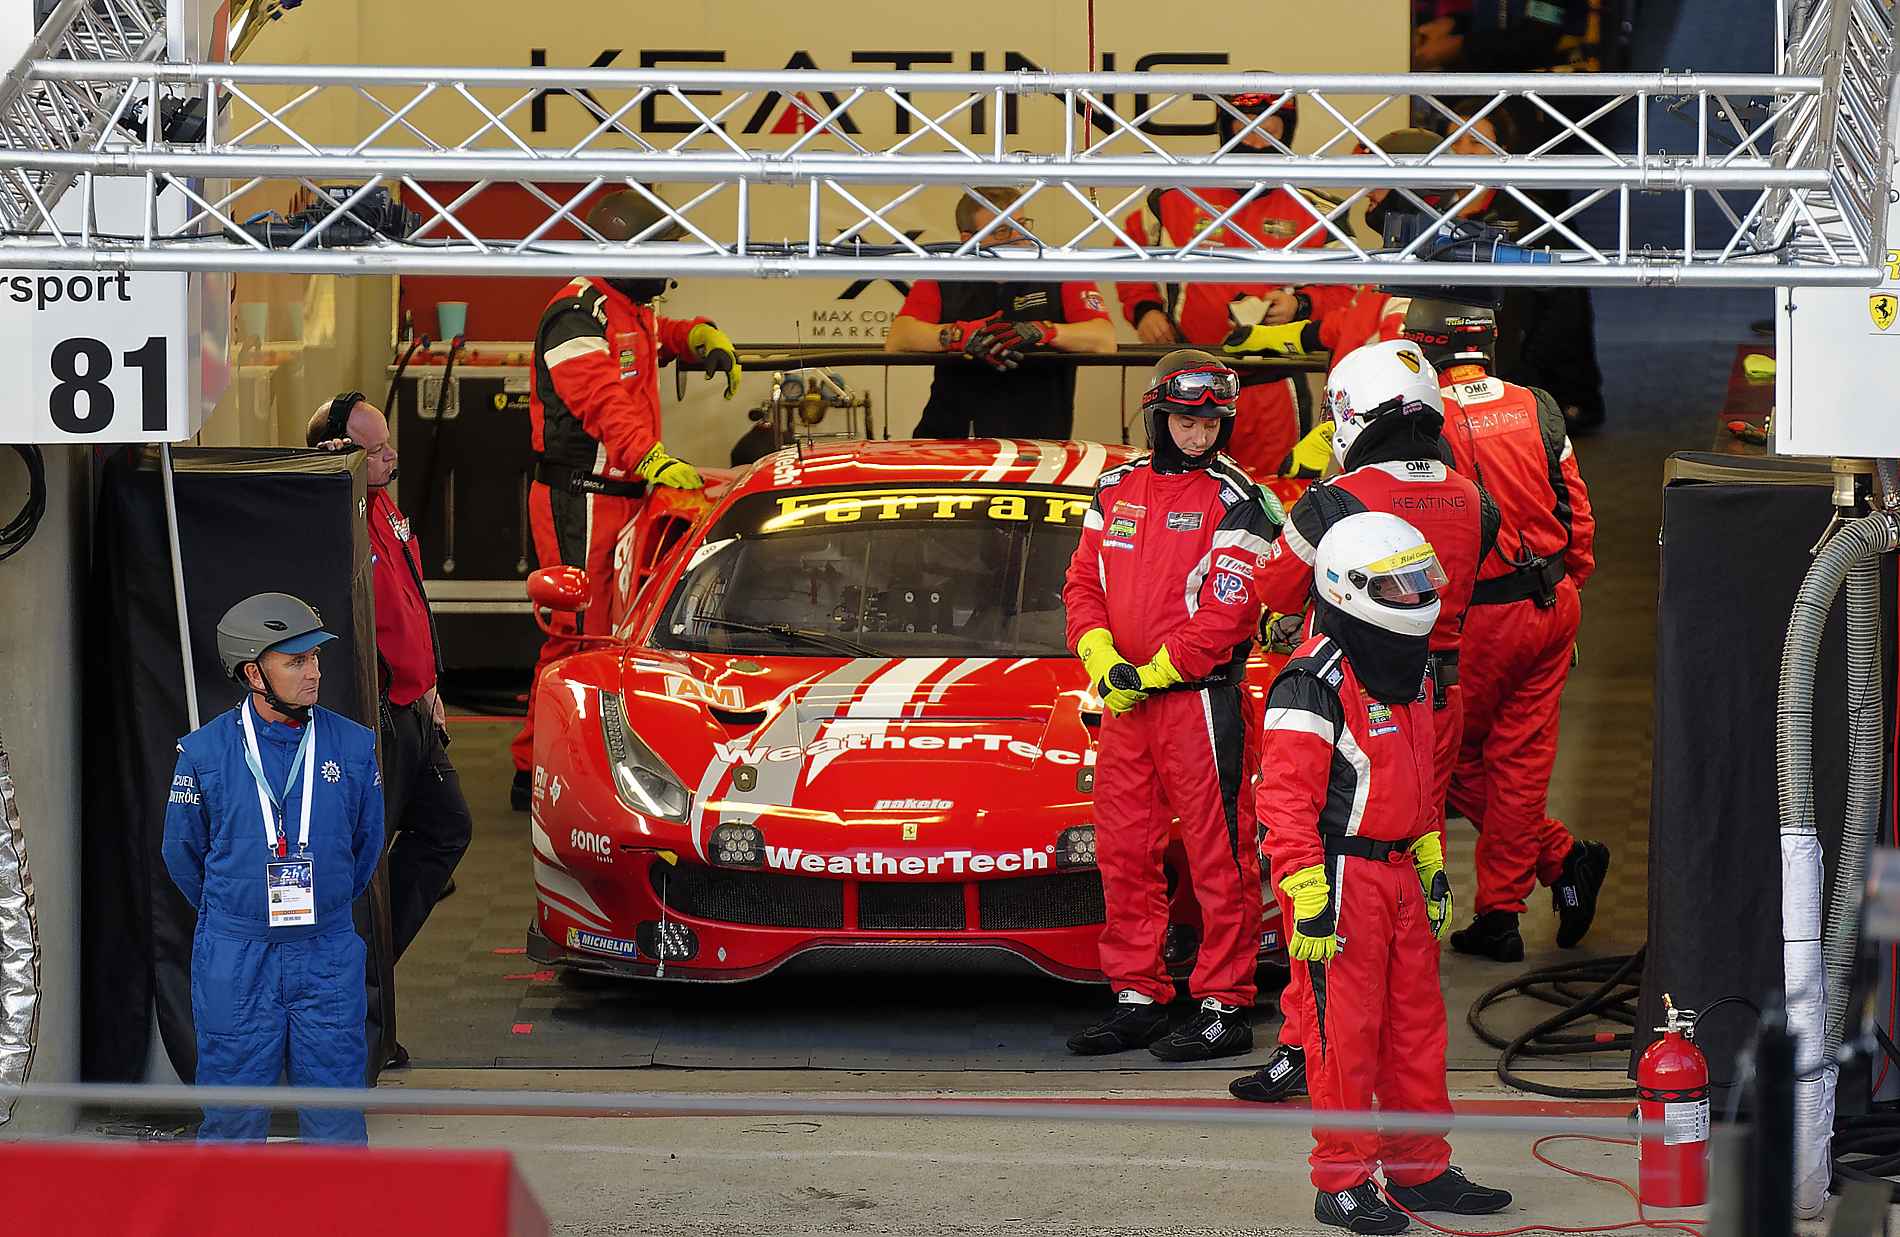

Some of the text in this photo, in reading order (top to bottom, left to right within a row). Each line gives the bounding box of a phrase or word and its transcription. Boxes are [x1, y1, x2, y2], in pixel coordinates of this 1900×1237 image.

[531, 49, 1228, 136] KEATING
[812, 310, 853, 322] MAX
[49, 337, 168, 434] 81
[1464, 382, 1489, 394] OMP
[1456, 407, 1528, 434] KEATING
[1406, 462, 1432, 472] OMP
[776, 486, 1093, 526] Ferrar
[1392, 496, 1466, 509] KEATING
[676, 678, 736, 706] AM
[581, 934, 634, 953] MICHELIN
[1205, 1022, 1223, 1040] OMP
[1270, 1059, 1290, 1079] OMP
[1337, 1191, 1355, 1211] OMP
